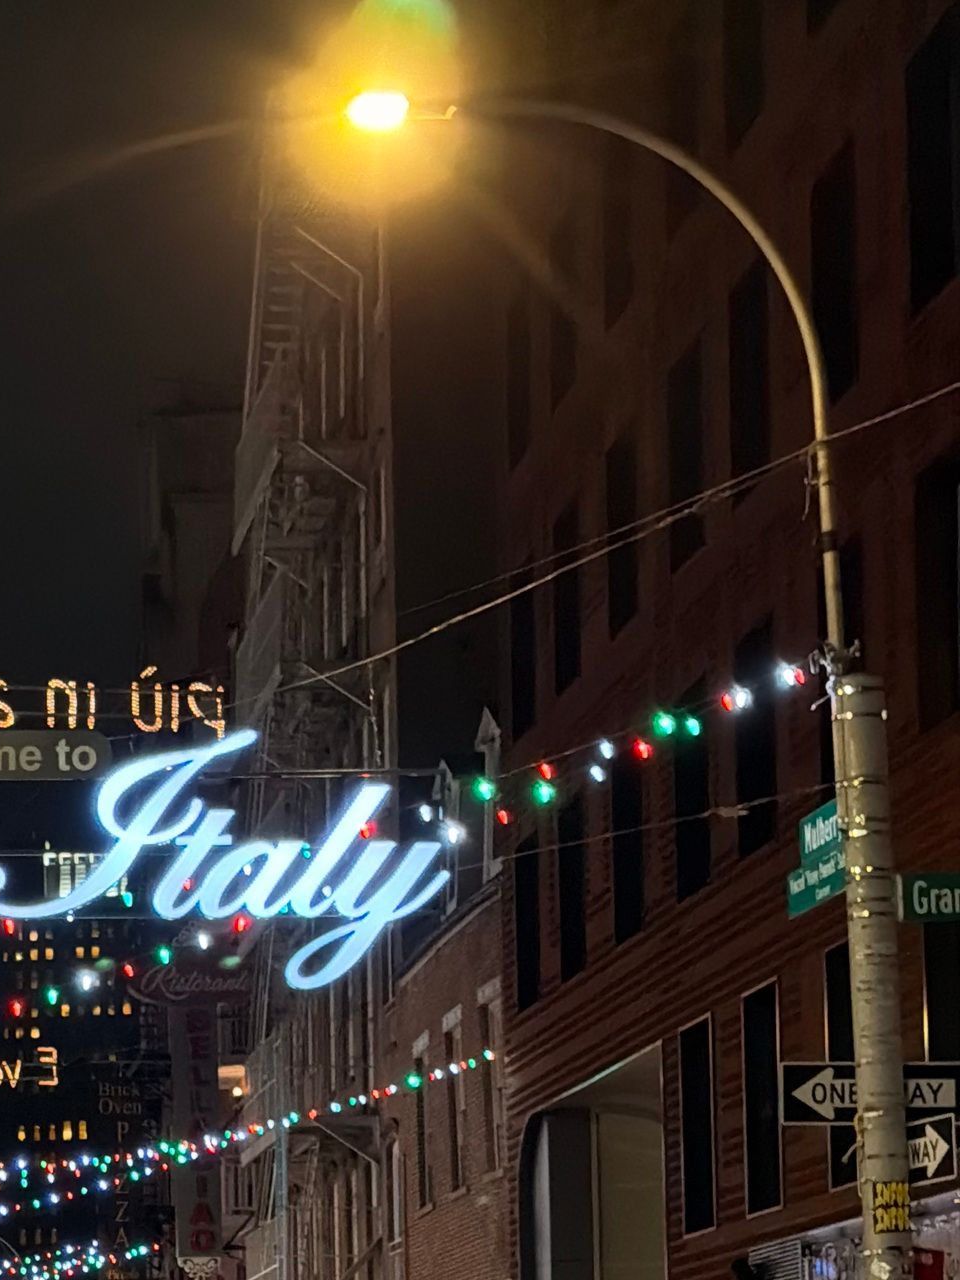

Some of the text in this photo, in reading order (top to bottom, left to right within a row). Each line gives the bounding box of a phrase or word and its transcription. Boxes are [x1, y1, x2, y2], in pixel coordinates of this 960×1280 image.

[54, 738, 98, 772] to
[97, 1081, 141, 1097] Brick
[811, 1082, 943, 1105] ONE AY
[98, 1099, 142, 1116] Oven
[909, 1138, 940, 1164] WAY
